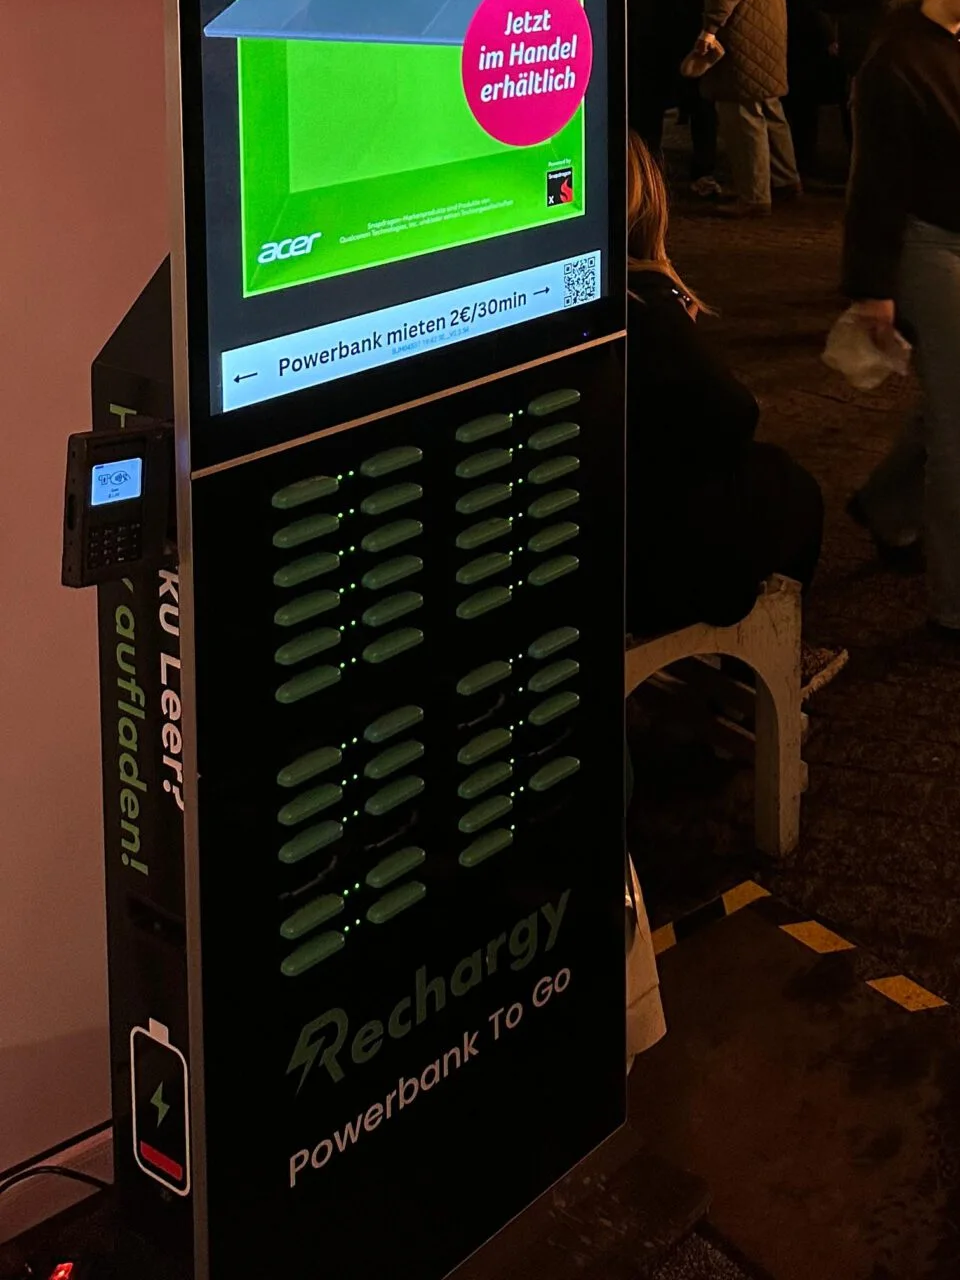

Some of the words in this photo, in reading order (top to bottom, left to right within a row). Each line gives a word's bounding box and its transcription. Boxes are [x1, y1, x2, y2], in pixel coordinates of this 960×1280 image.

[478, 45, 504, 70] im
[508, 35, 577, 67] Handel
[504, 9, 551, 36] Jetzt
[480, 66, 575, 103] erhältlich
[257, 231, 322, 264] acer
[279, 331, 382, 377] Powerbank
[387, 316, 446, 346] mieten
[450, 290, 527, 327] 2€/30min
[115, 604, 149, 876] aufladen!
[285, 888, 571, 1099] Rechargy
[289, 1030, 479, 1188] Powerbank
[488, 1001, 523, 1040] To
[532, 967, 571, 1007] Go
